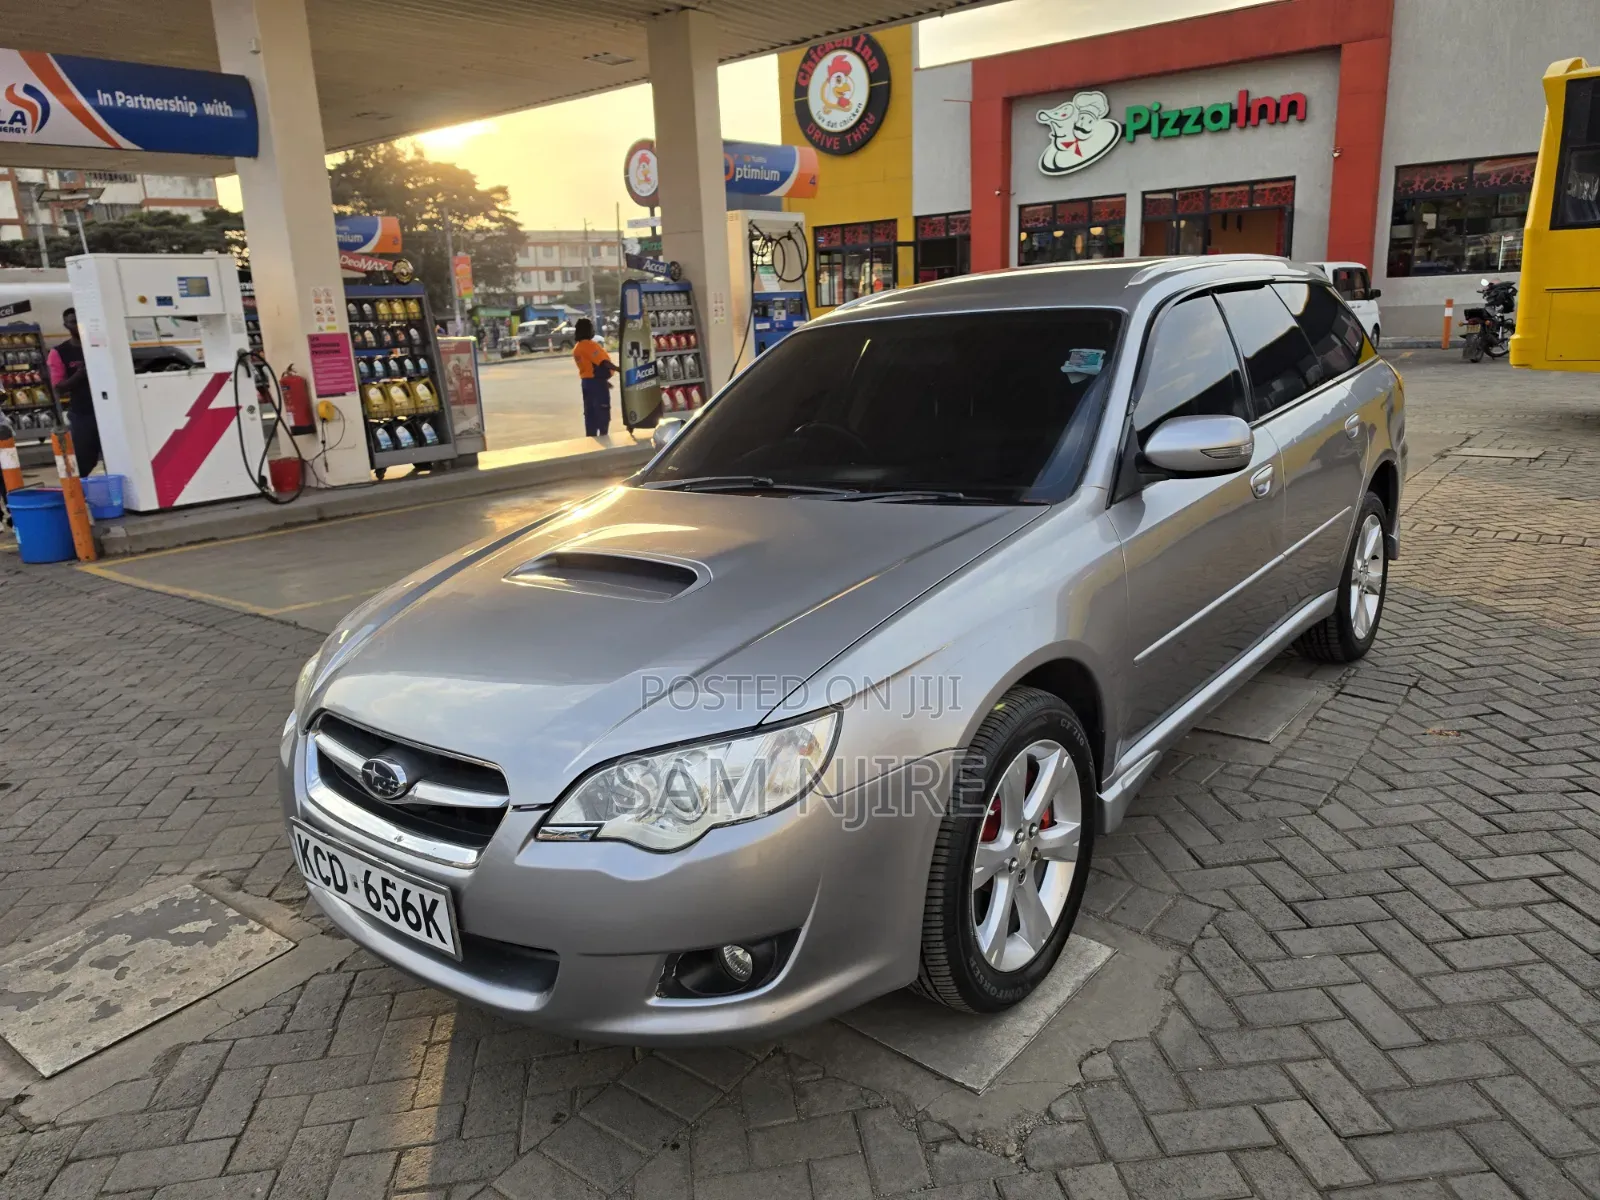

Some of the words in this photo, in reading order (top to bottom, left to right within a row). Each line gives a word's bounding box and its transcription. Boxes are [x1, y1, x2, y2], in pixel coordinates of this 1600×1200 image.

[798, 36, 853, 86] Chicken
[855, 34, 879, 73] Inn
[97, 89, 113, 106] In
[115, 91, 198, 117] Partnership
[202, 98, 233, 117] with
[807, 123, 840, 150] DRIVE
[845, 112, 876, 147] THRU
[809, 174, 816, 186] 4
[642, 259, 667, 274] Accel
[635, 365, 655, 381] Accel
[297, 834, 348, 895] KCD
[363, 869, 448, 945] 656K
